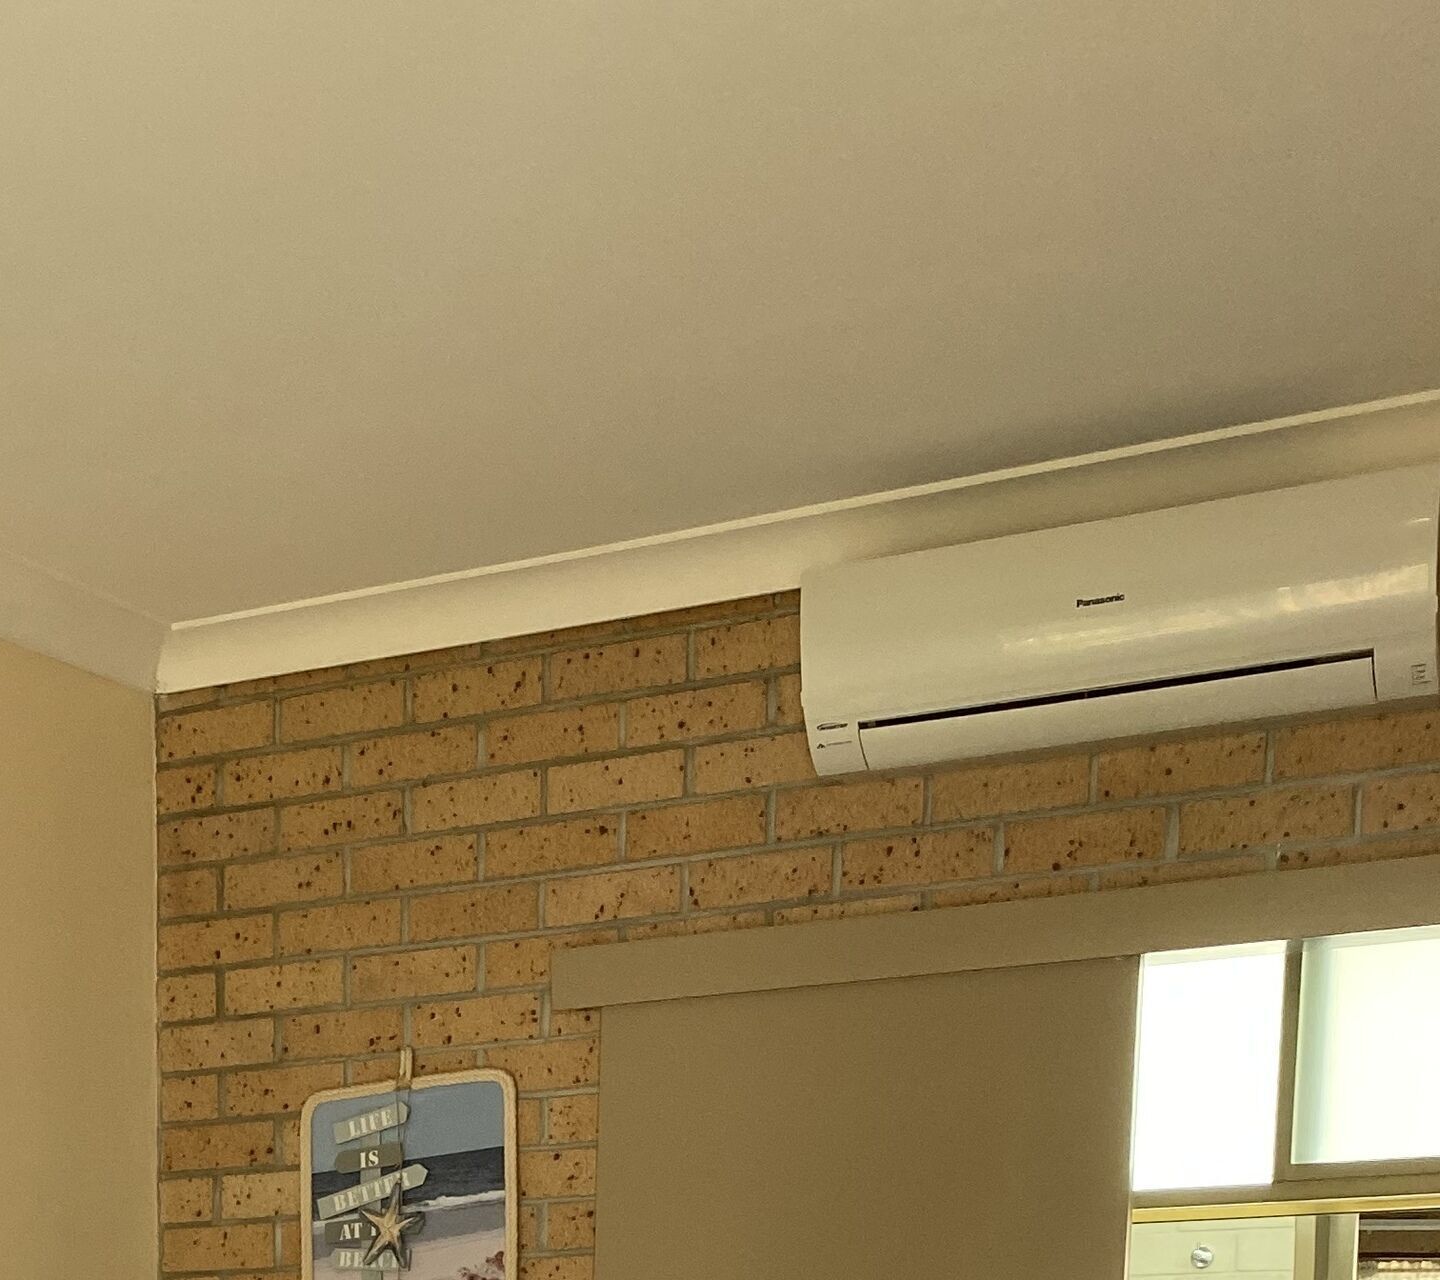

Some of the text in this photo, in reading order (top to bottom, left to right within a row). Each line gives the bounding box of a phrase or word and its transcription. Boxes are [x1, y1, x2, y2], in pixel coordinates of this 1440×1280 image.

[1076, 594, 1125, 607] Panasonic
[349, 1109, 393, 1137] LIFE
[360, 1150, 380, 1169] IS
[339, 1222, 363, 1241] AT
